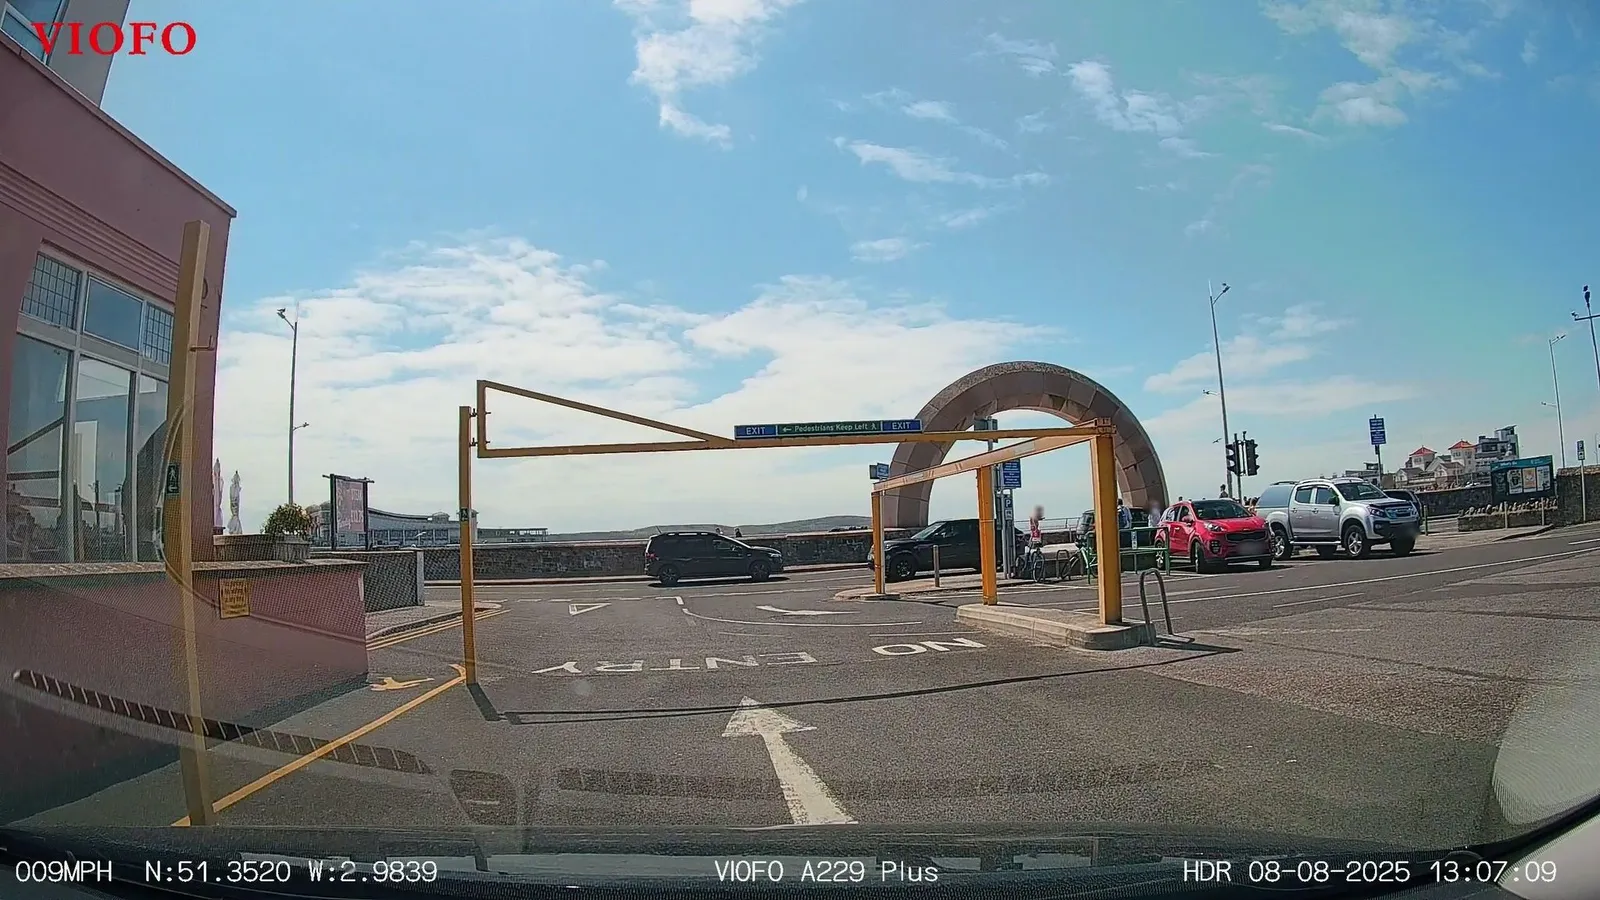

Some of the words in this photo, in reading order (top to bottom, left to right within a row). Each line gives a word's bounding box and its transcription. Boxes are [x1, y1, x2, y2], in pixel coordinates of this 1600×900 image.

[794, 424, 834, 432] Pedestrians
[835, 423, 852, 431] Keep
[891, 421, 911, 430] EXIT
[746, 426, 766, 435] EXIT
[871, 637, 986, 656] NO
[531, 652, 818, 674] ENTRY
